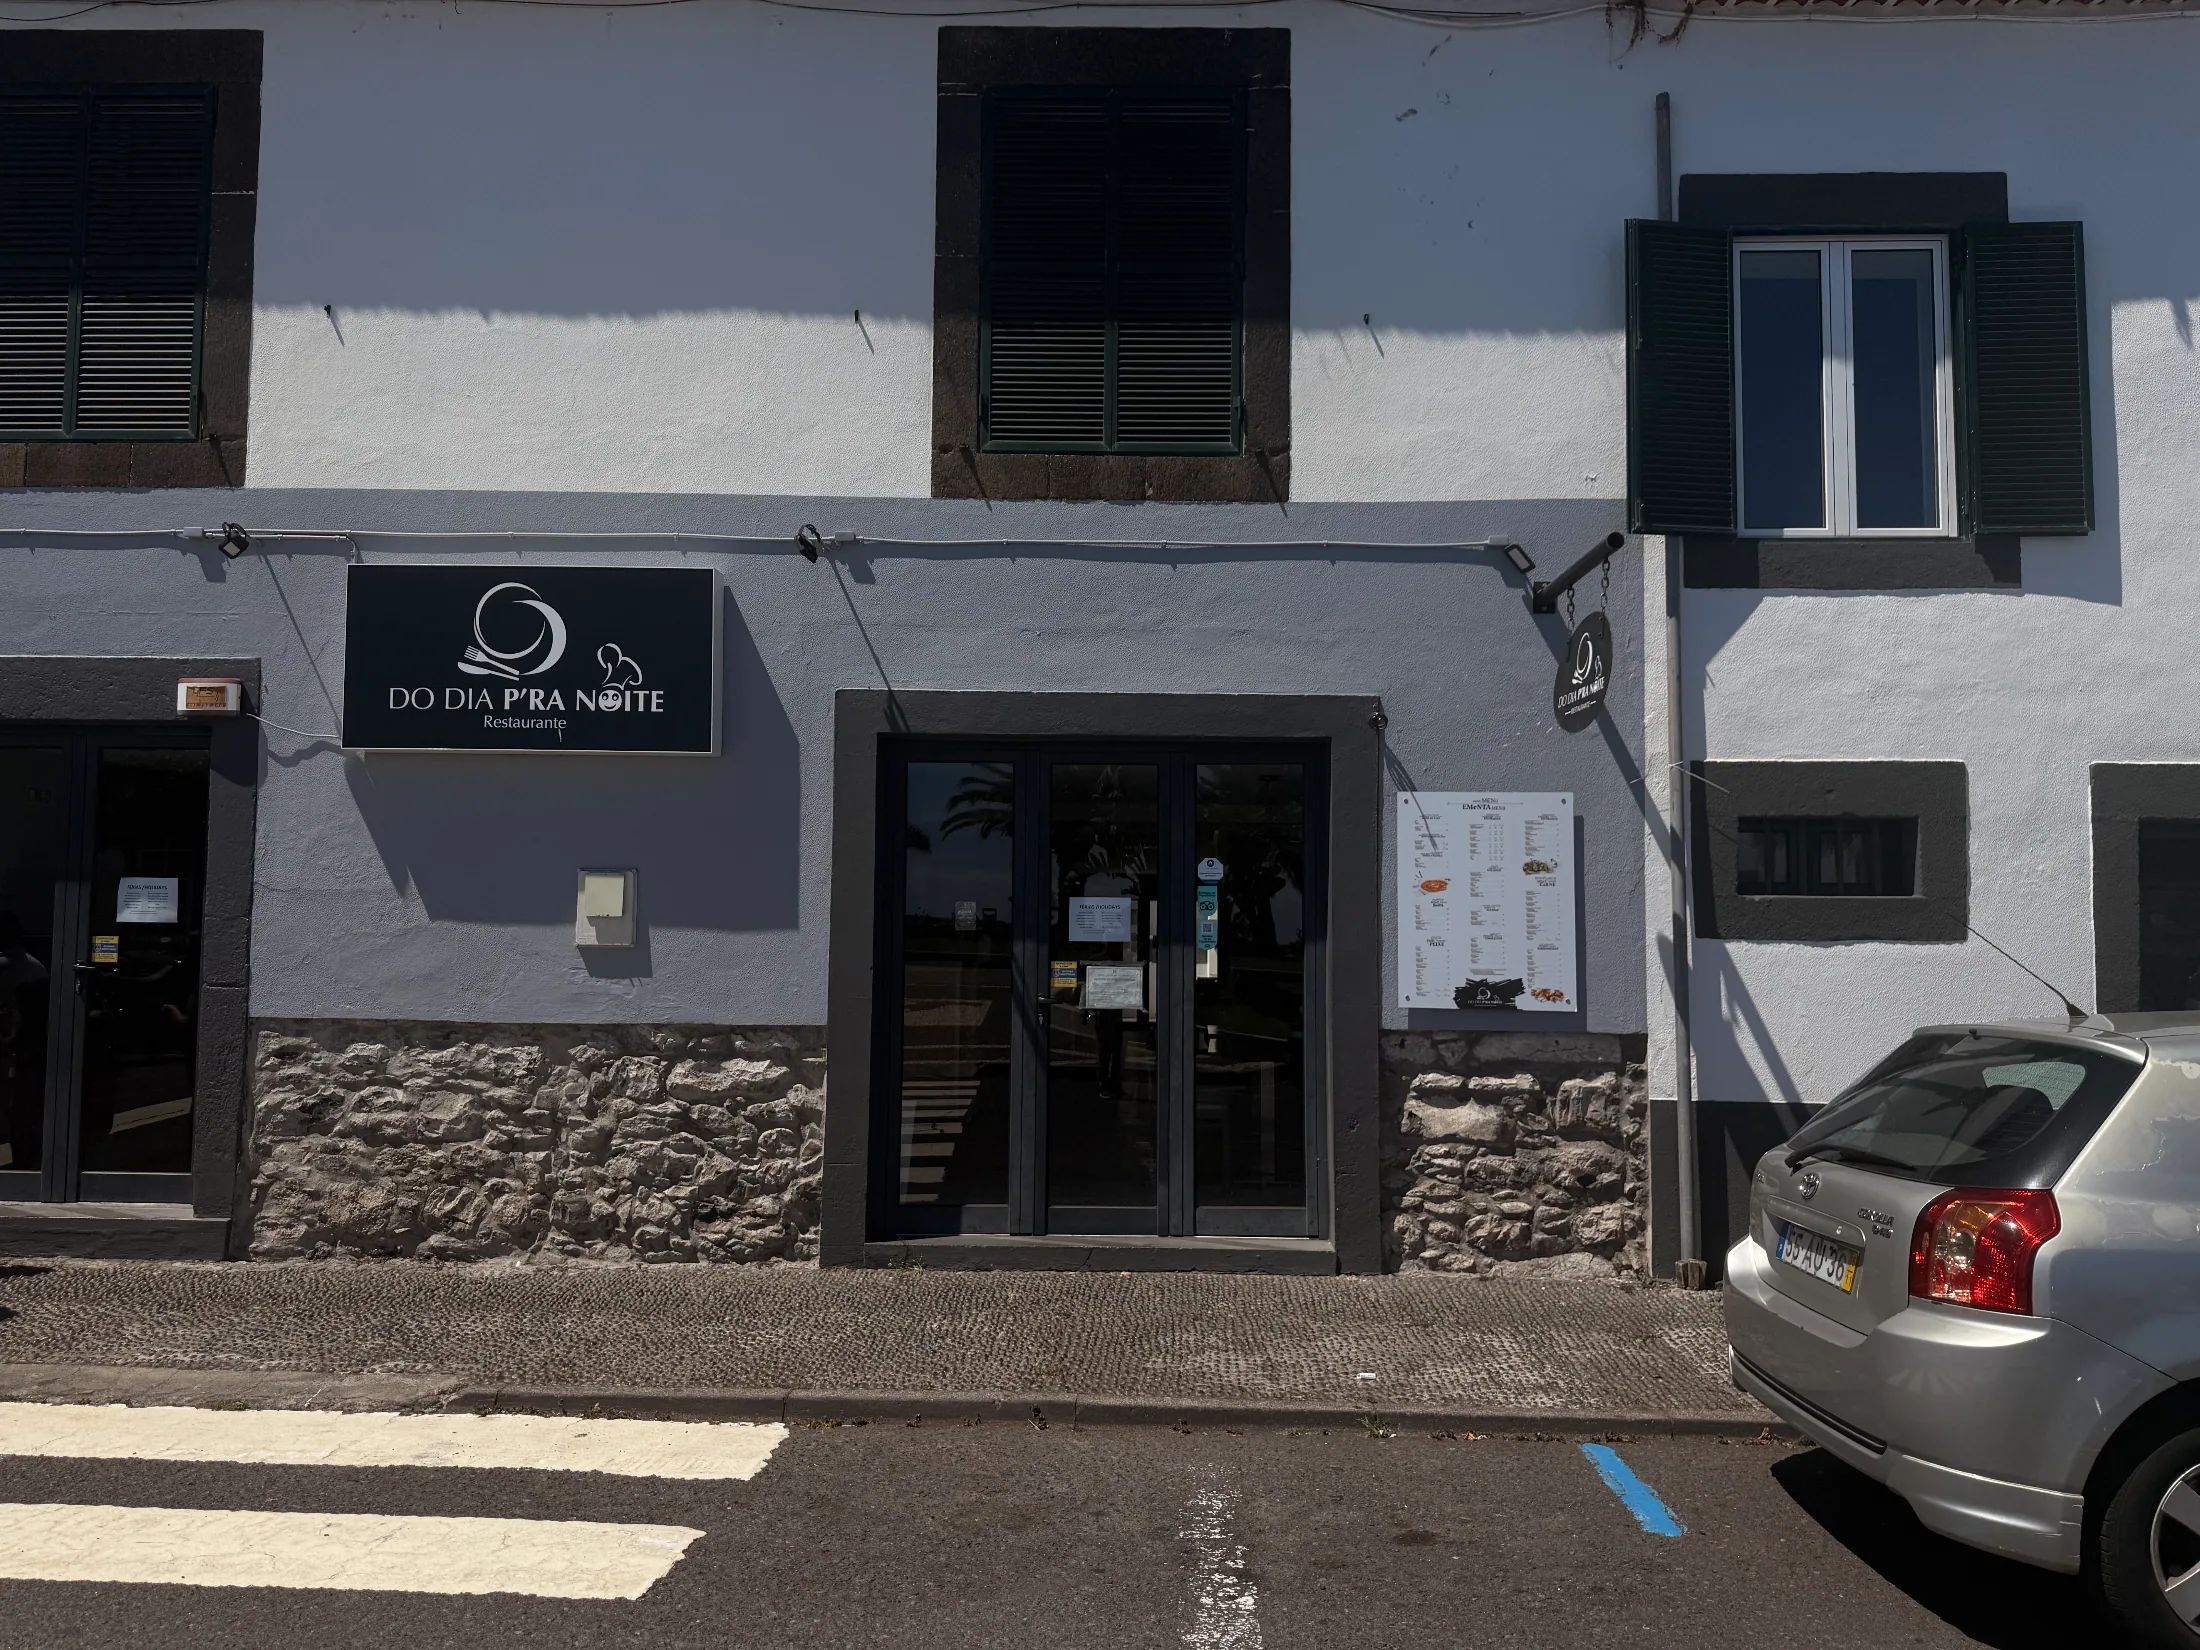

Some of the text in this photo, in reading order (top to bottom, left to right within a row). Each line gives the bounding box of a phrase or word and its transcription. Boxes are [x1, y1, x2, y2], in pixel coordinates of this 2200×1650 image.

[389, 687, 664, 713] DO DIA P'RA NOITE
[483, 715, 567, 730] Restaurante
